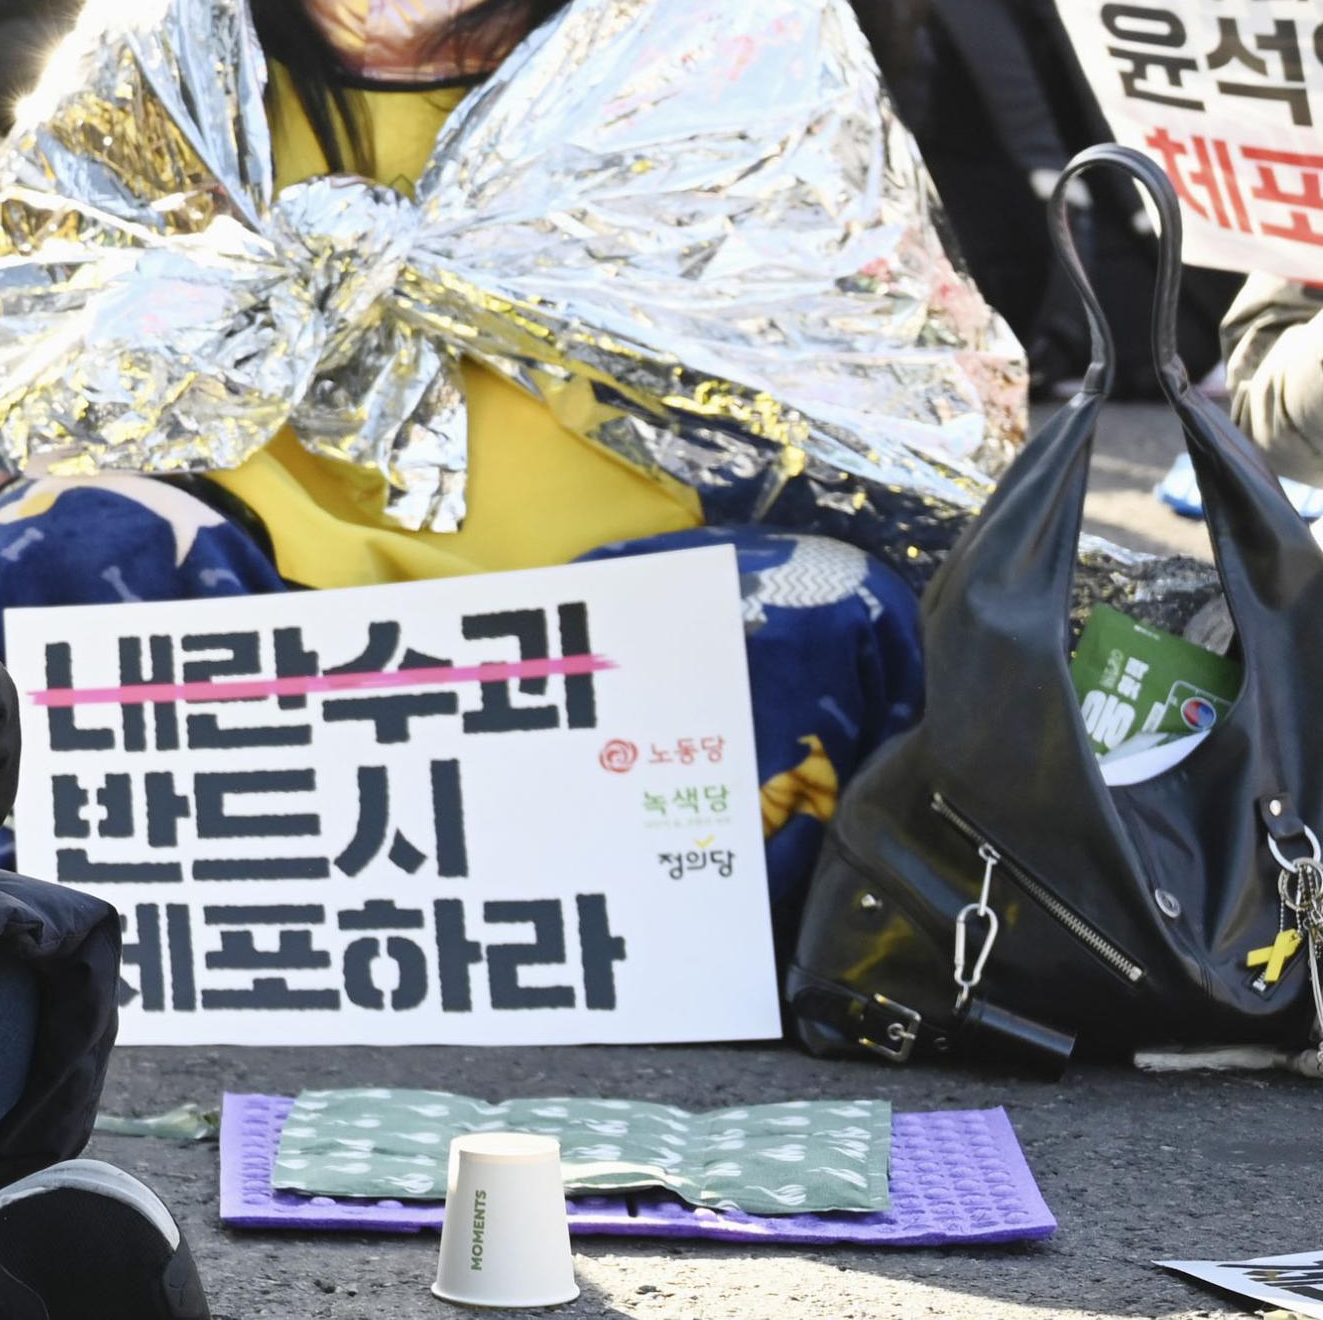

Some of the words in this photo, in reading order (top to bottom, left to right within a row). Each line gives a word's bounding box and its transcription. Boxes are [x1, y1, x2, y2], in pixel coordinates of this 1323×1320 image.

[1100, 2, 1323, 128] 윤석
[45, 601, 597, 752] 내란수괴
[649, 734, 726, 765] 노동당
[51, 759, 468, 884] 반드시
[642, 783, 730, 816] 녹색당
[658, 849, 736, 881] 정의당
[470, 1189, 487, 1272] MOMENTS
